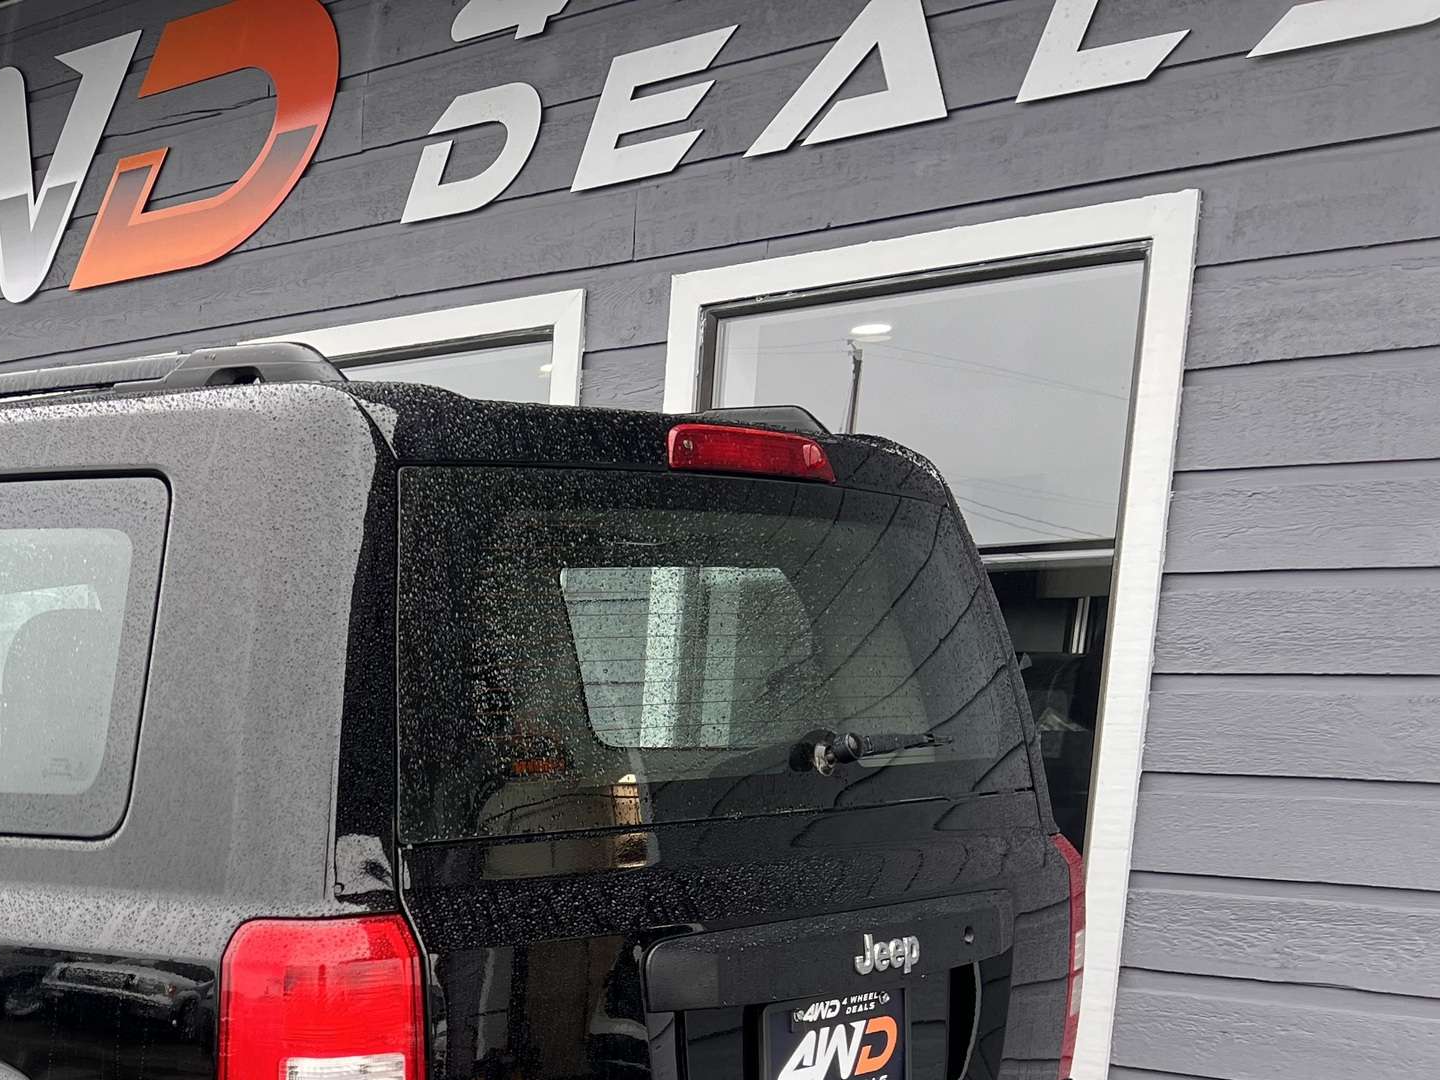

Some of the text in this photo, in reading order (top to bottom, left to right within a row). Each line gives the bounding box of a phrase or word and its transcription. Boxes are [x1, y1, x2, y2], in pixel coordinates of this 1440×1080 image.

[400, 0, 1440, 224] DEAL
[855, 933, 920, 975] Jeep
[803, 992, 879, 1022] 4WD 4 WHEEL
[846, 1001, 876, 1014] DEALS
